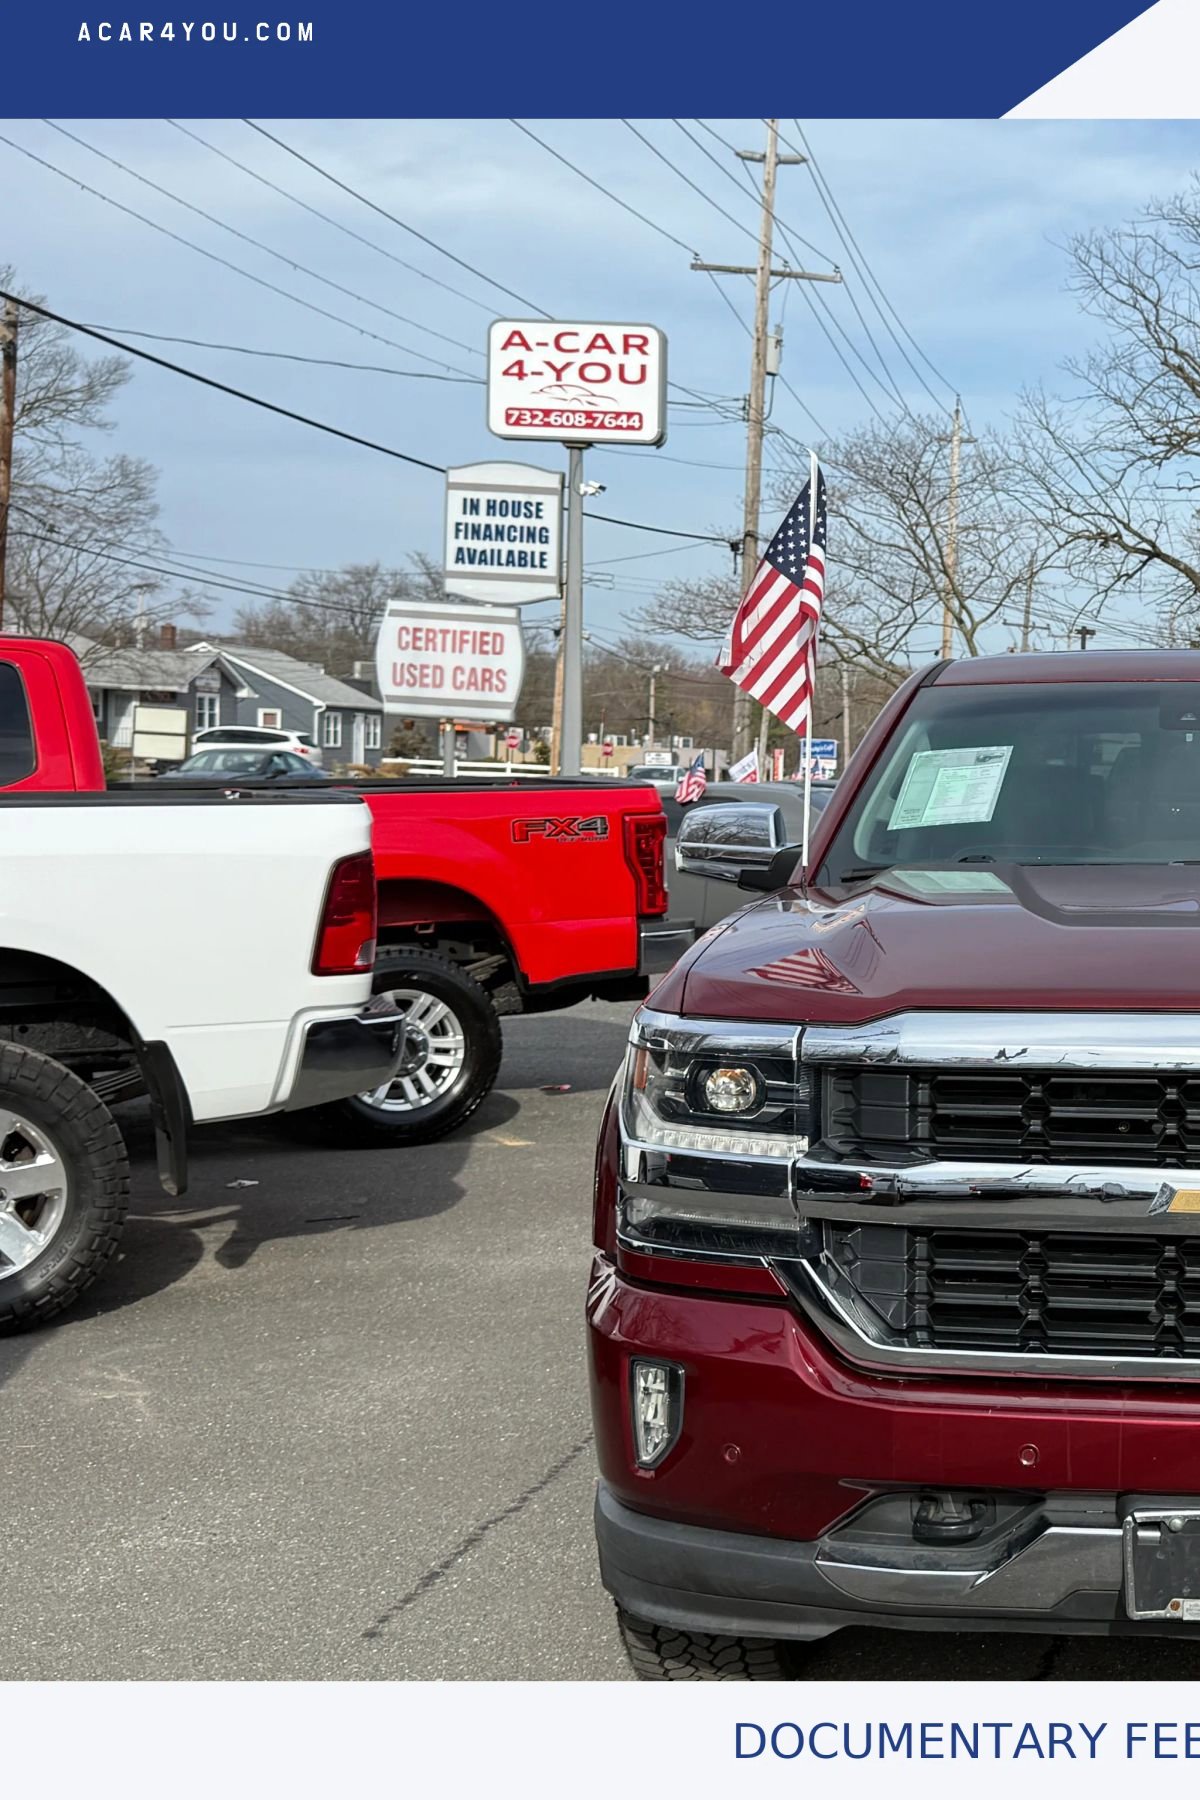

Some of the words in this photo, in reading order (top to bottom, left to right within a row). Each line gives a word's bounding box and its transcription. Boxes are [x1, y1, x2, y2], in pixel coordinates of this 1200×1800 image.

[500, 330, 650, 356] A-CAR
[501, 359, 647, 385] 4-YOU
[507, 410, 641, 429] 732-608-7644
[462, 497, 480, 516] IN
[486, 499, 544, 519] HOUSE
[454, 522, 550, 545] FINANCING
[454, 546, 548, 569] AVAILABLE
[397, 626, 505, 656] CERTIFIED
[392, 662, 445, 689] USED
[451, 666, 507, 693] CARS
[511, 815, 609, 843] FX4
